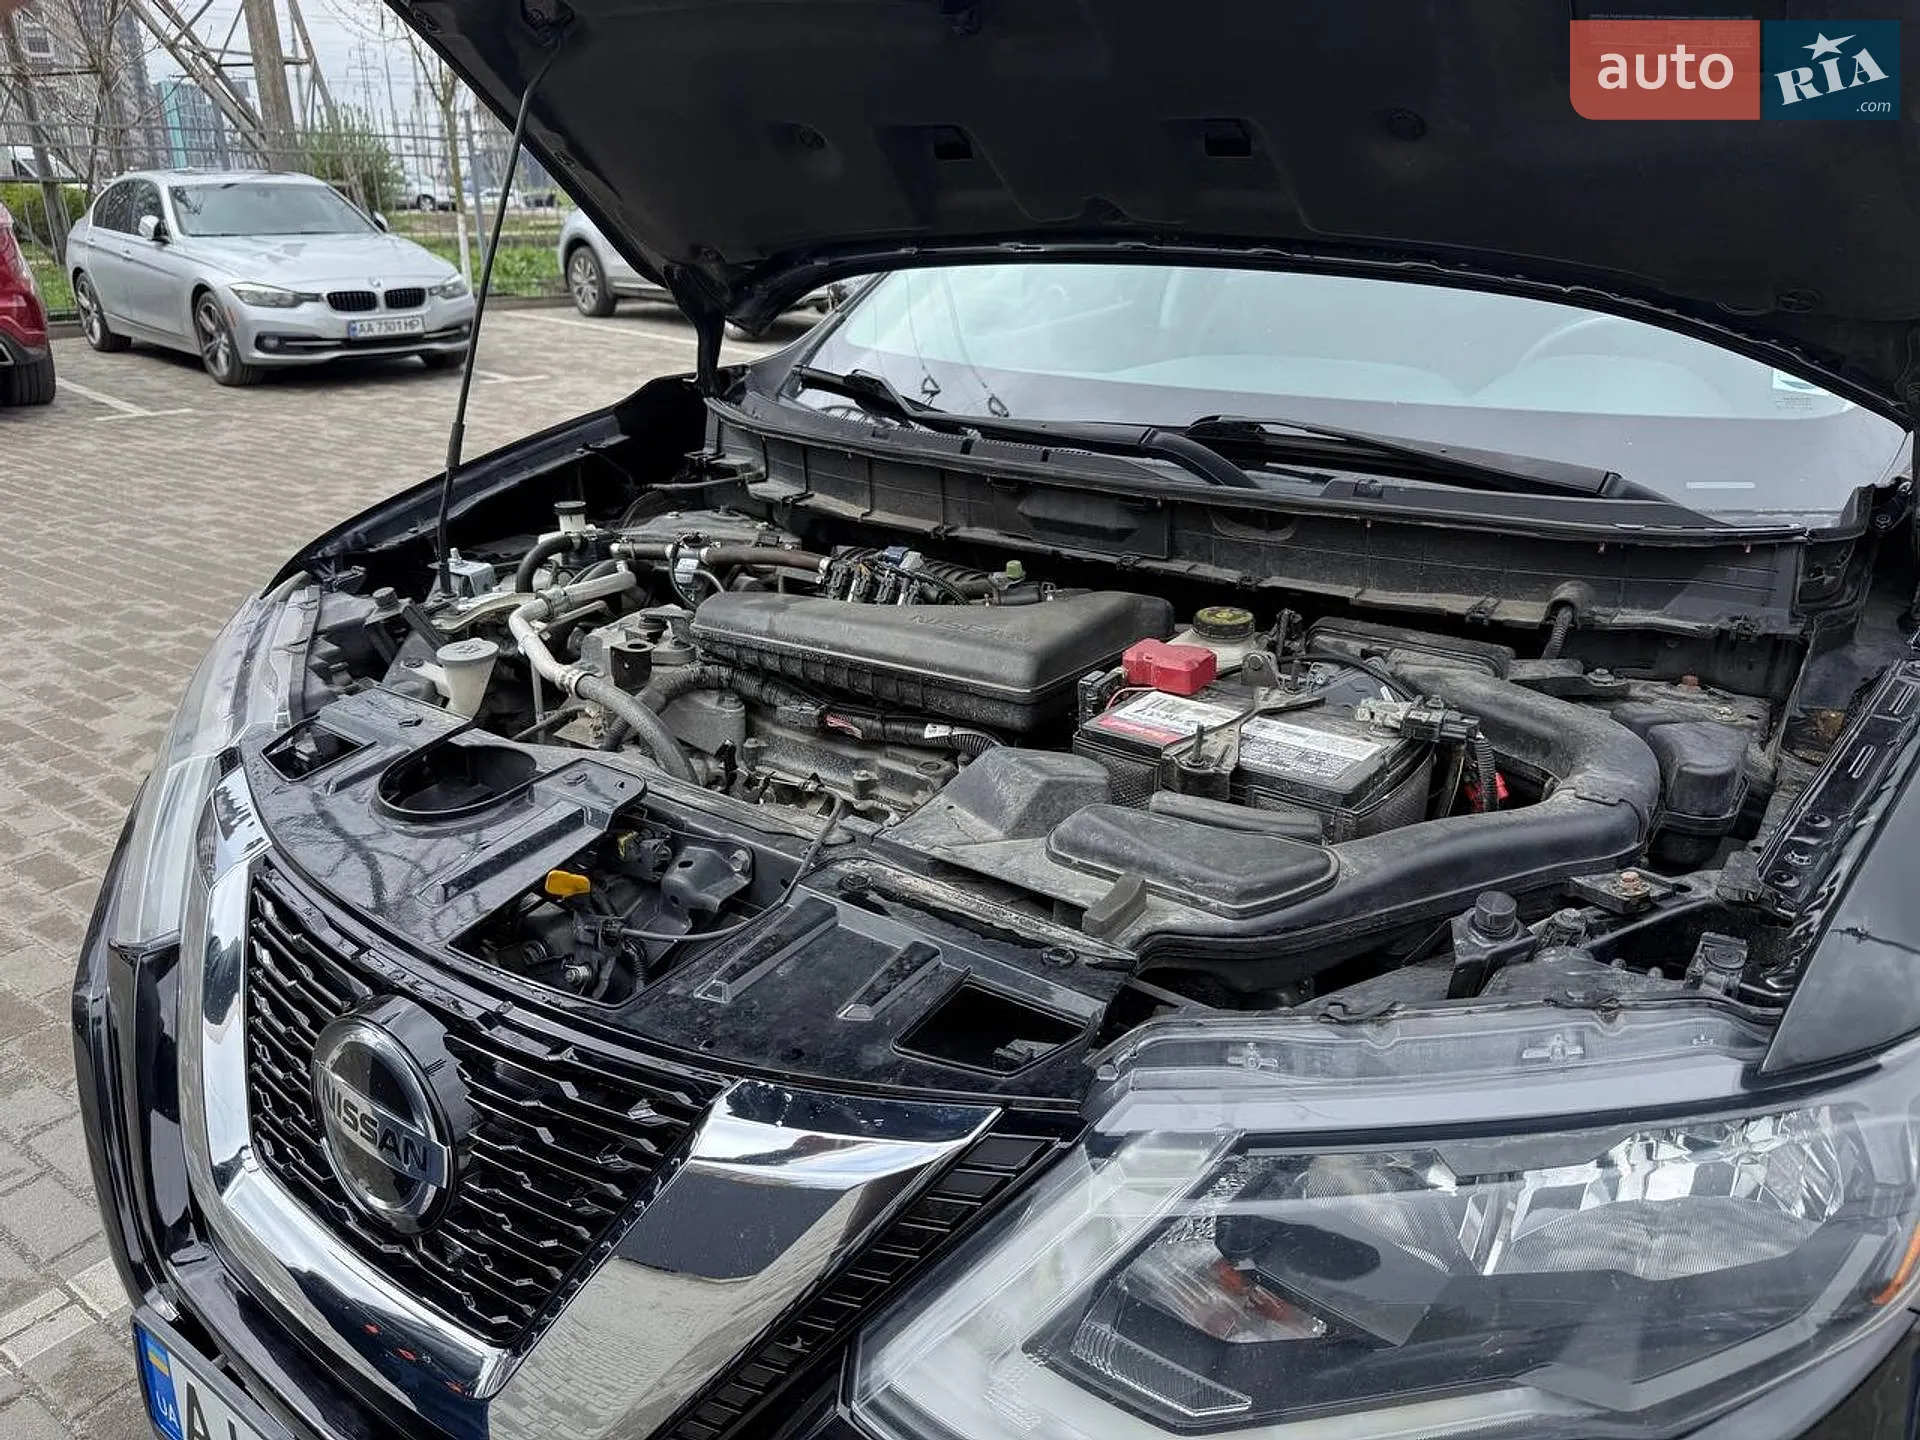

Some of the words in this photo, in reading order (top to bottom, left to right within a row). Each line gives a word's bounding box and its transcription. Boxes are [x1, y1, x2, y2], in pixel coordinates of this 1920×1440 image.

[359, 322, 374, 334] AA
[319, 1070, 428, 1172] NISSAN
[156, 1391, 180, 1429] UA
